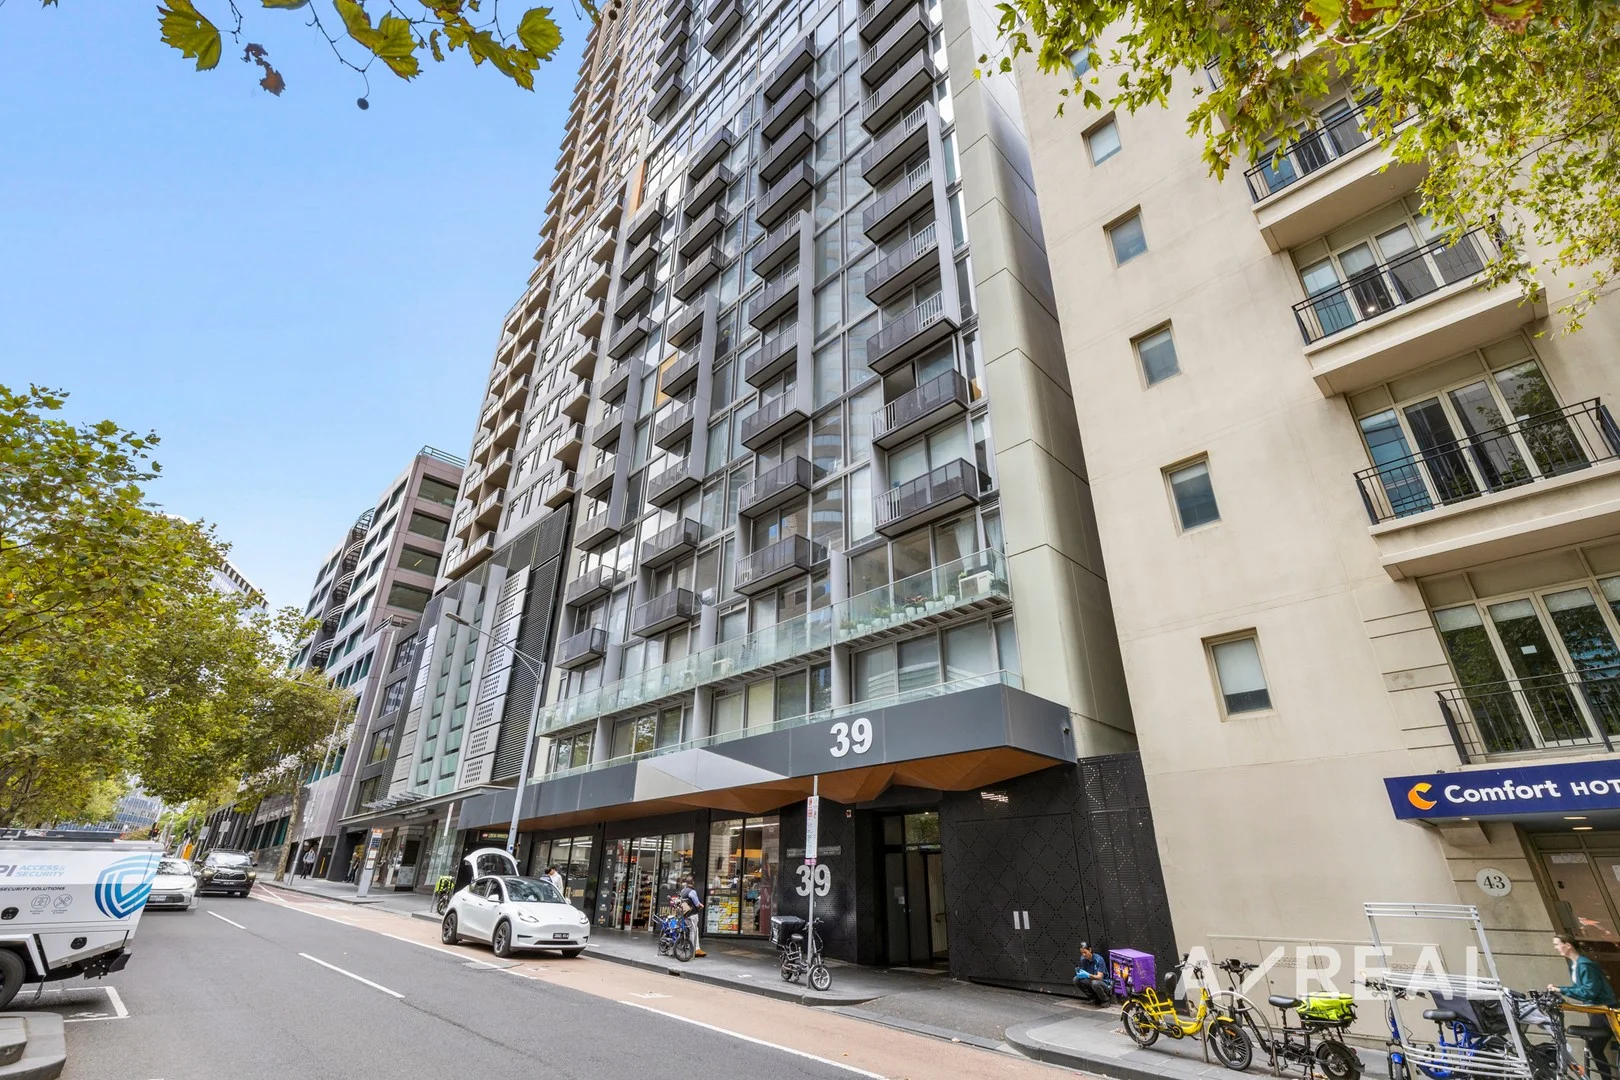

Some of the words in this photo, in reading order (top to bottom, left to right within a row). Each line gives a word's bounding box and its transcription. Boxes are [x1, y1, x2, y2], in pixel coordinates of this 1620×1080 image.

[829, 717, 873, 758] 39
[1444, 780, 1562, 804] Comfort
[1570, 779, 1620, 796] HOT
[795, 863, 831, 897] 39
[1483, 875, 1506, 890] 43
